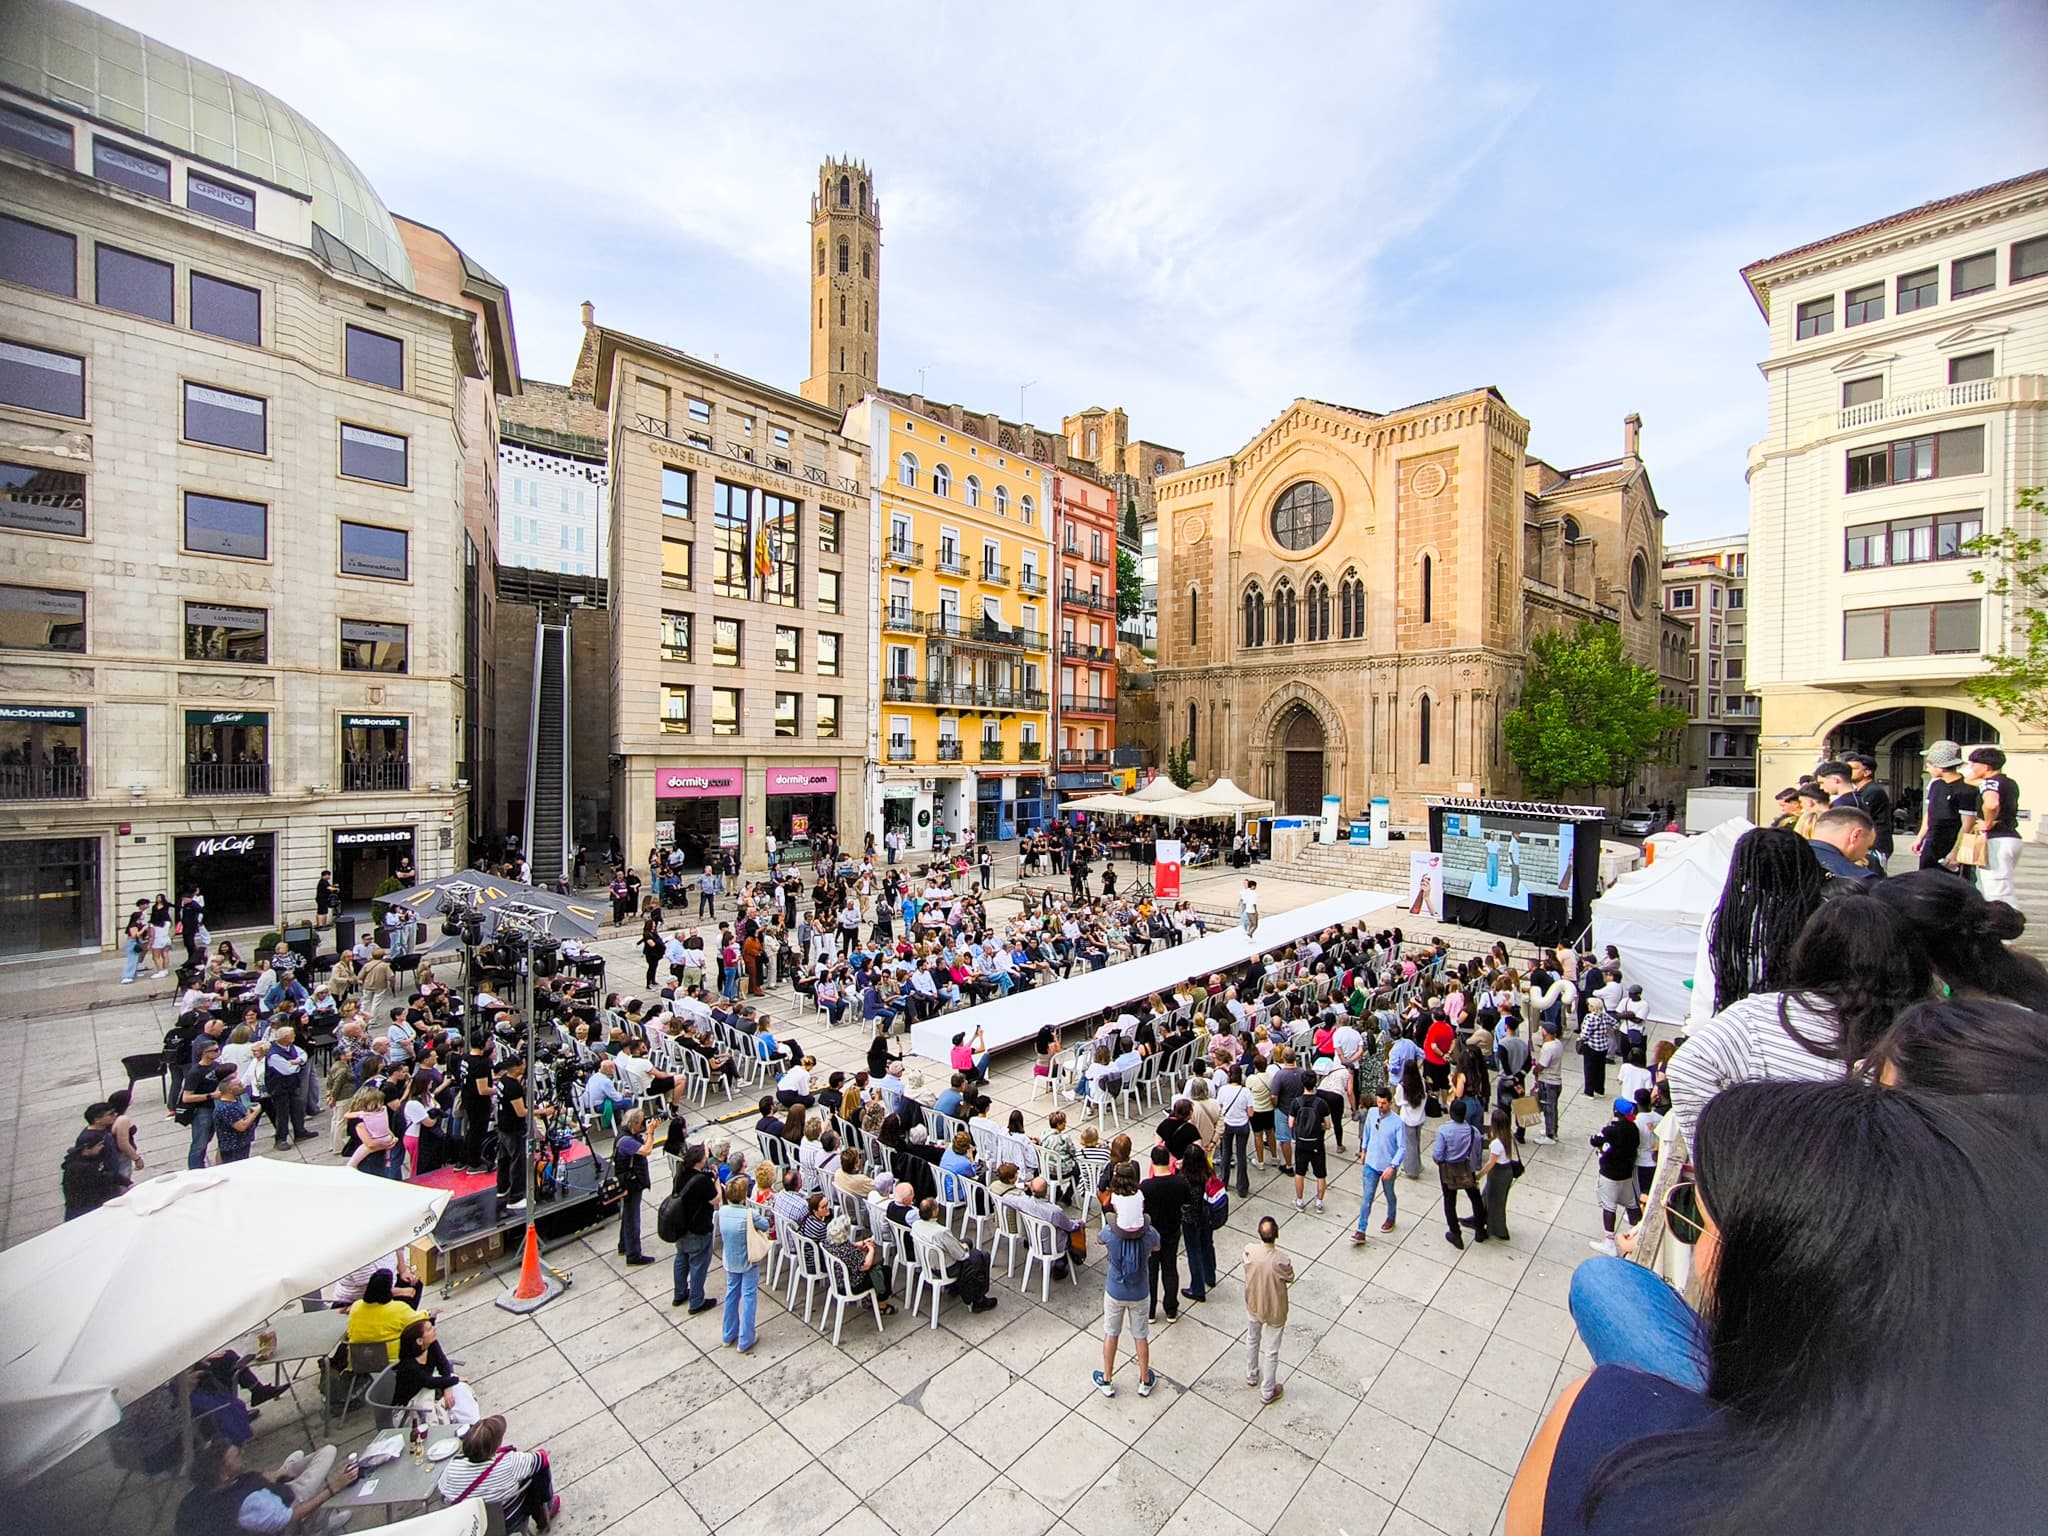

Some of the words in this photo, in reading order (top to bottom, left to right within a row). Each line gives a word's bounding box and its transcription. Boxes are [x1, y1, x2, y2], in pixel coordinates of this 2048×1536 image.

[649, 442, 711, 469] CONSELL
[794, 485, 814, 498] DEL
[101, 559, 136, 577] DE
[159, 566, 276, 593] ESPAÑA
[0, 708, 76, 719] McDonald's
[349, 718, 401, 726] McDonald's
[668, 776, 731, 789] dormity.com
[776, 774, 828, 786] dormity.com
[337, 831, 411, 844] McDonald's
[195, 835, 256, 857] McCafé
